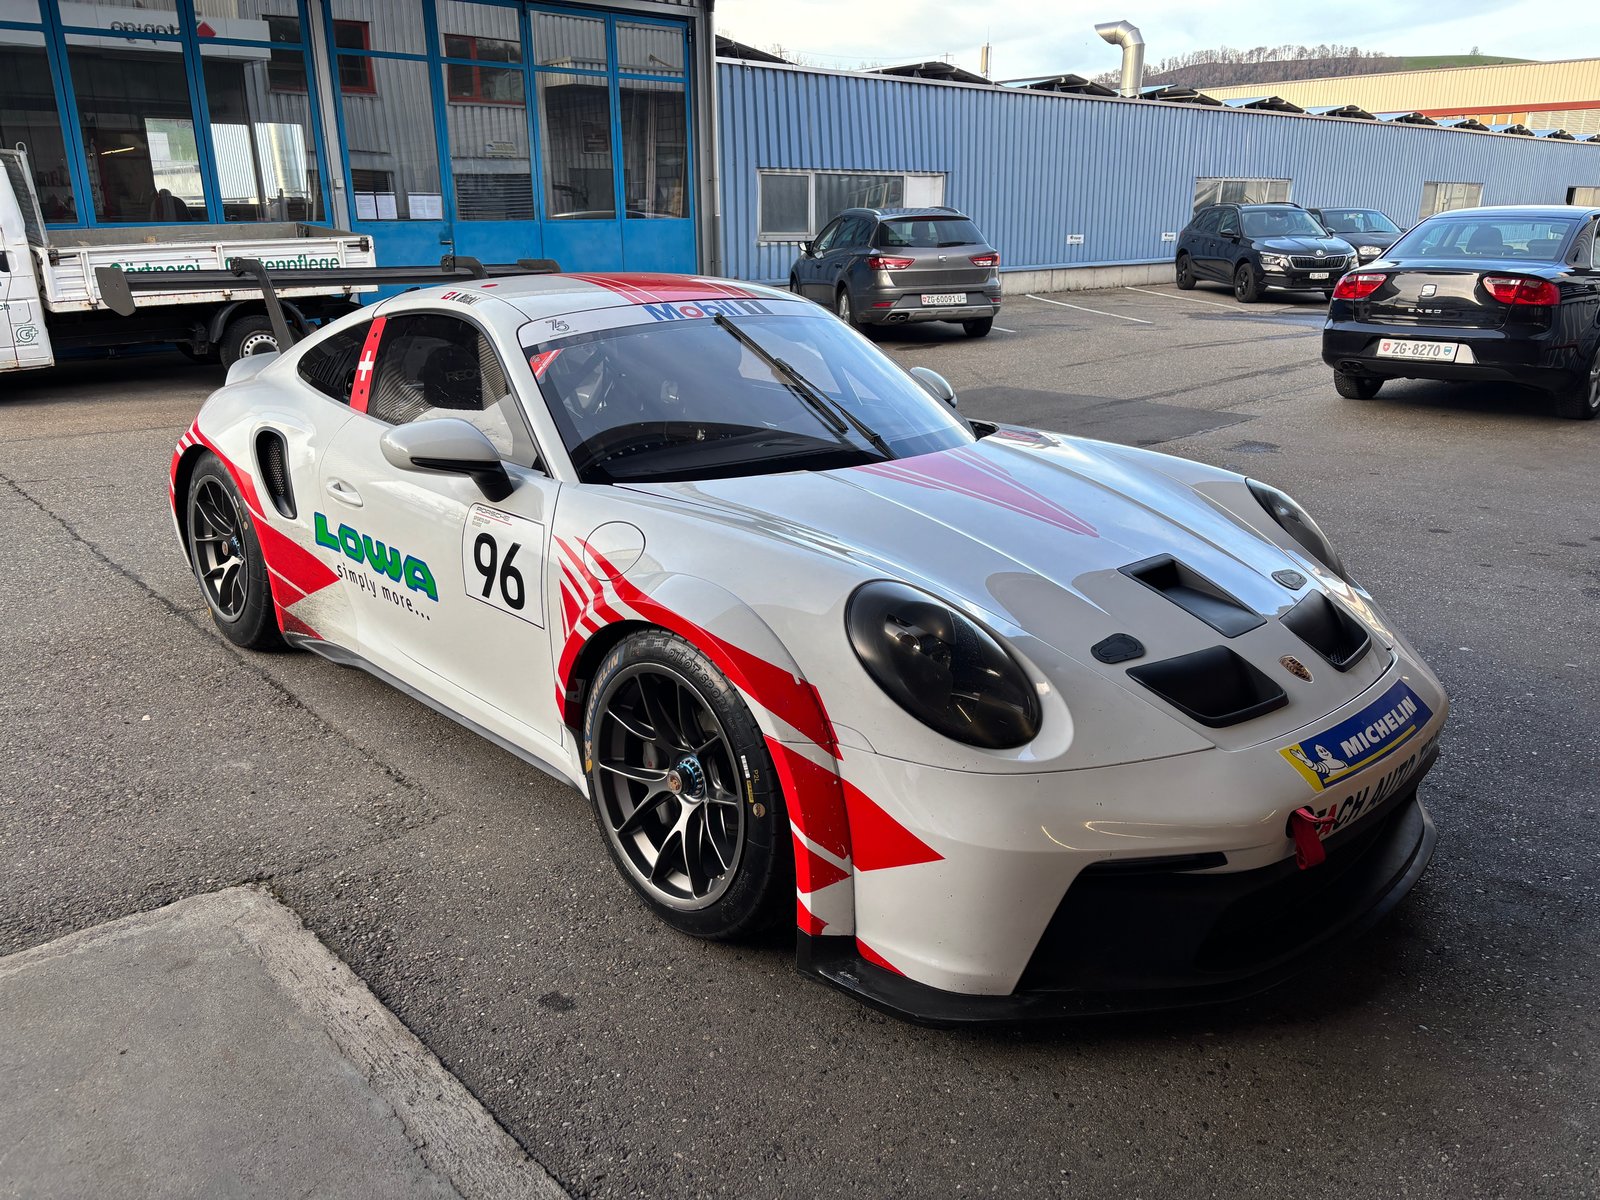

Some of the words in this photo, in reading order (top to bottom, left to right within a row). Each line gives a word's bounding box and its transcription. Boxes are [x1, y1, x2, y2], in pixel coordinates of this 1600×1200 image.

[642, 301, 746, 321] Mobil
[476, 506, 510, 522] PORSCHE
[314, 511, 439, 603] LOWA
[473, 532, 526, 611] 96
[336, 562, 377, 598] simply
[381, 582, 431, 621] more...
[586, 652, 619, 736] MICHELIN
[668, 648, 701, 673] PILOT
[700, 673, 730, 713] SPORT
[1340, 695, 1418, 759] MICHELIN
